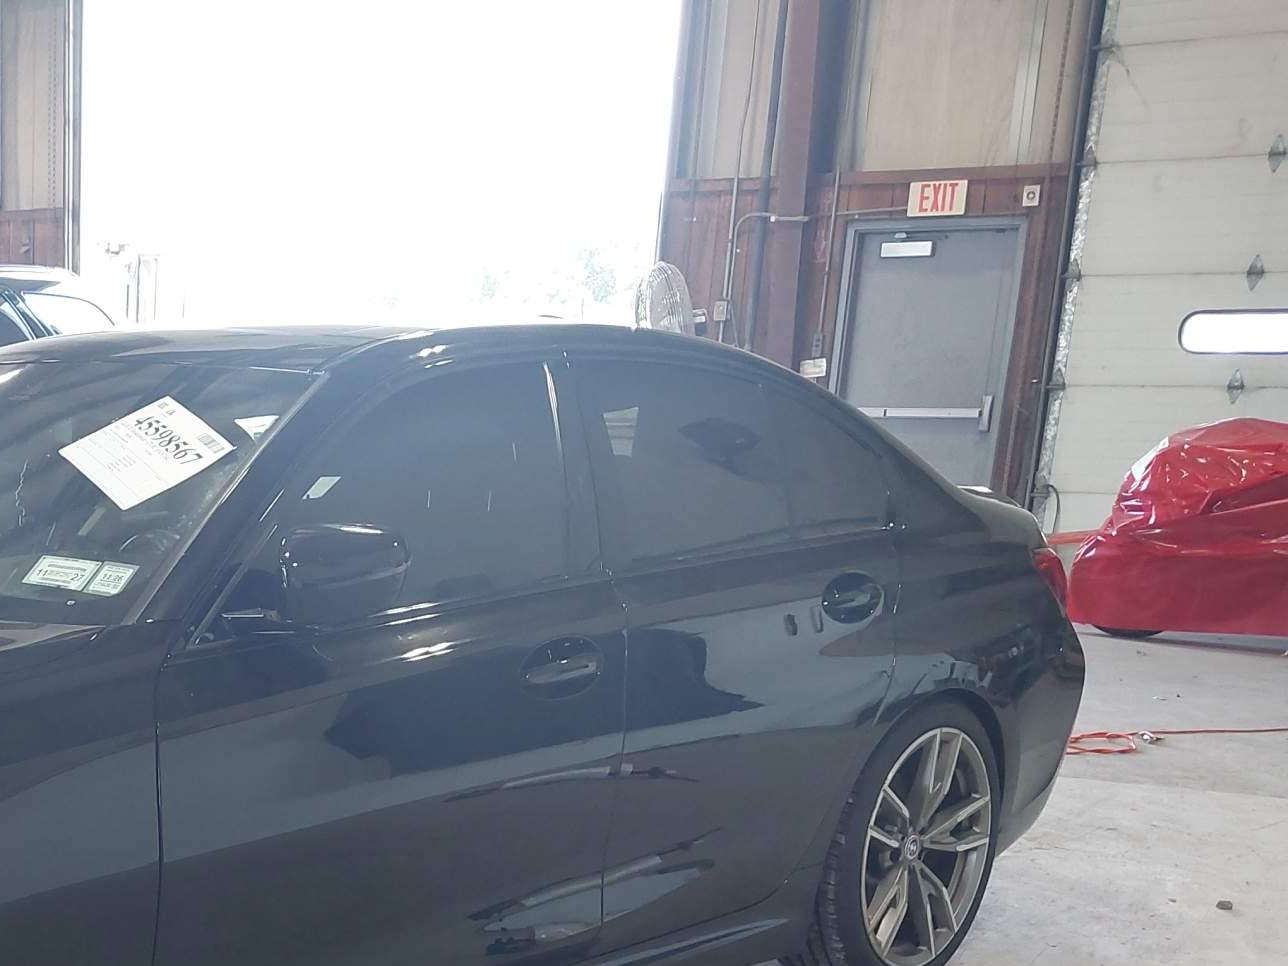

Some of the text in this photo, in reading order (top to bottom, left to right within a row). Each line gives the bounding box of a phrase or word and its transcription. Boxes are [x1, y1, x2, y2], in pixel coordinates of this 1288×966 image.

[918, 183, 959, 213] EXIT
[134, 415, 204, 465] 45598567
[69, 573, 86, 582] 27
